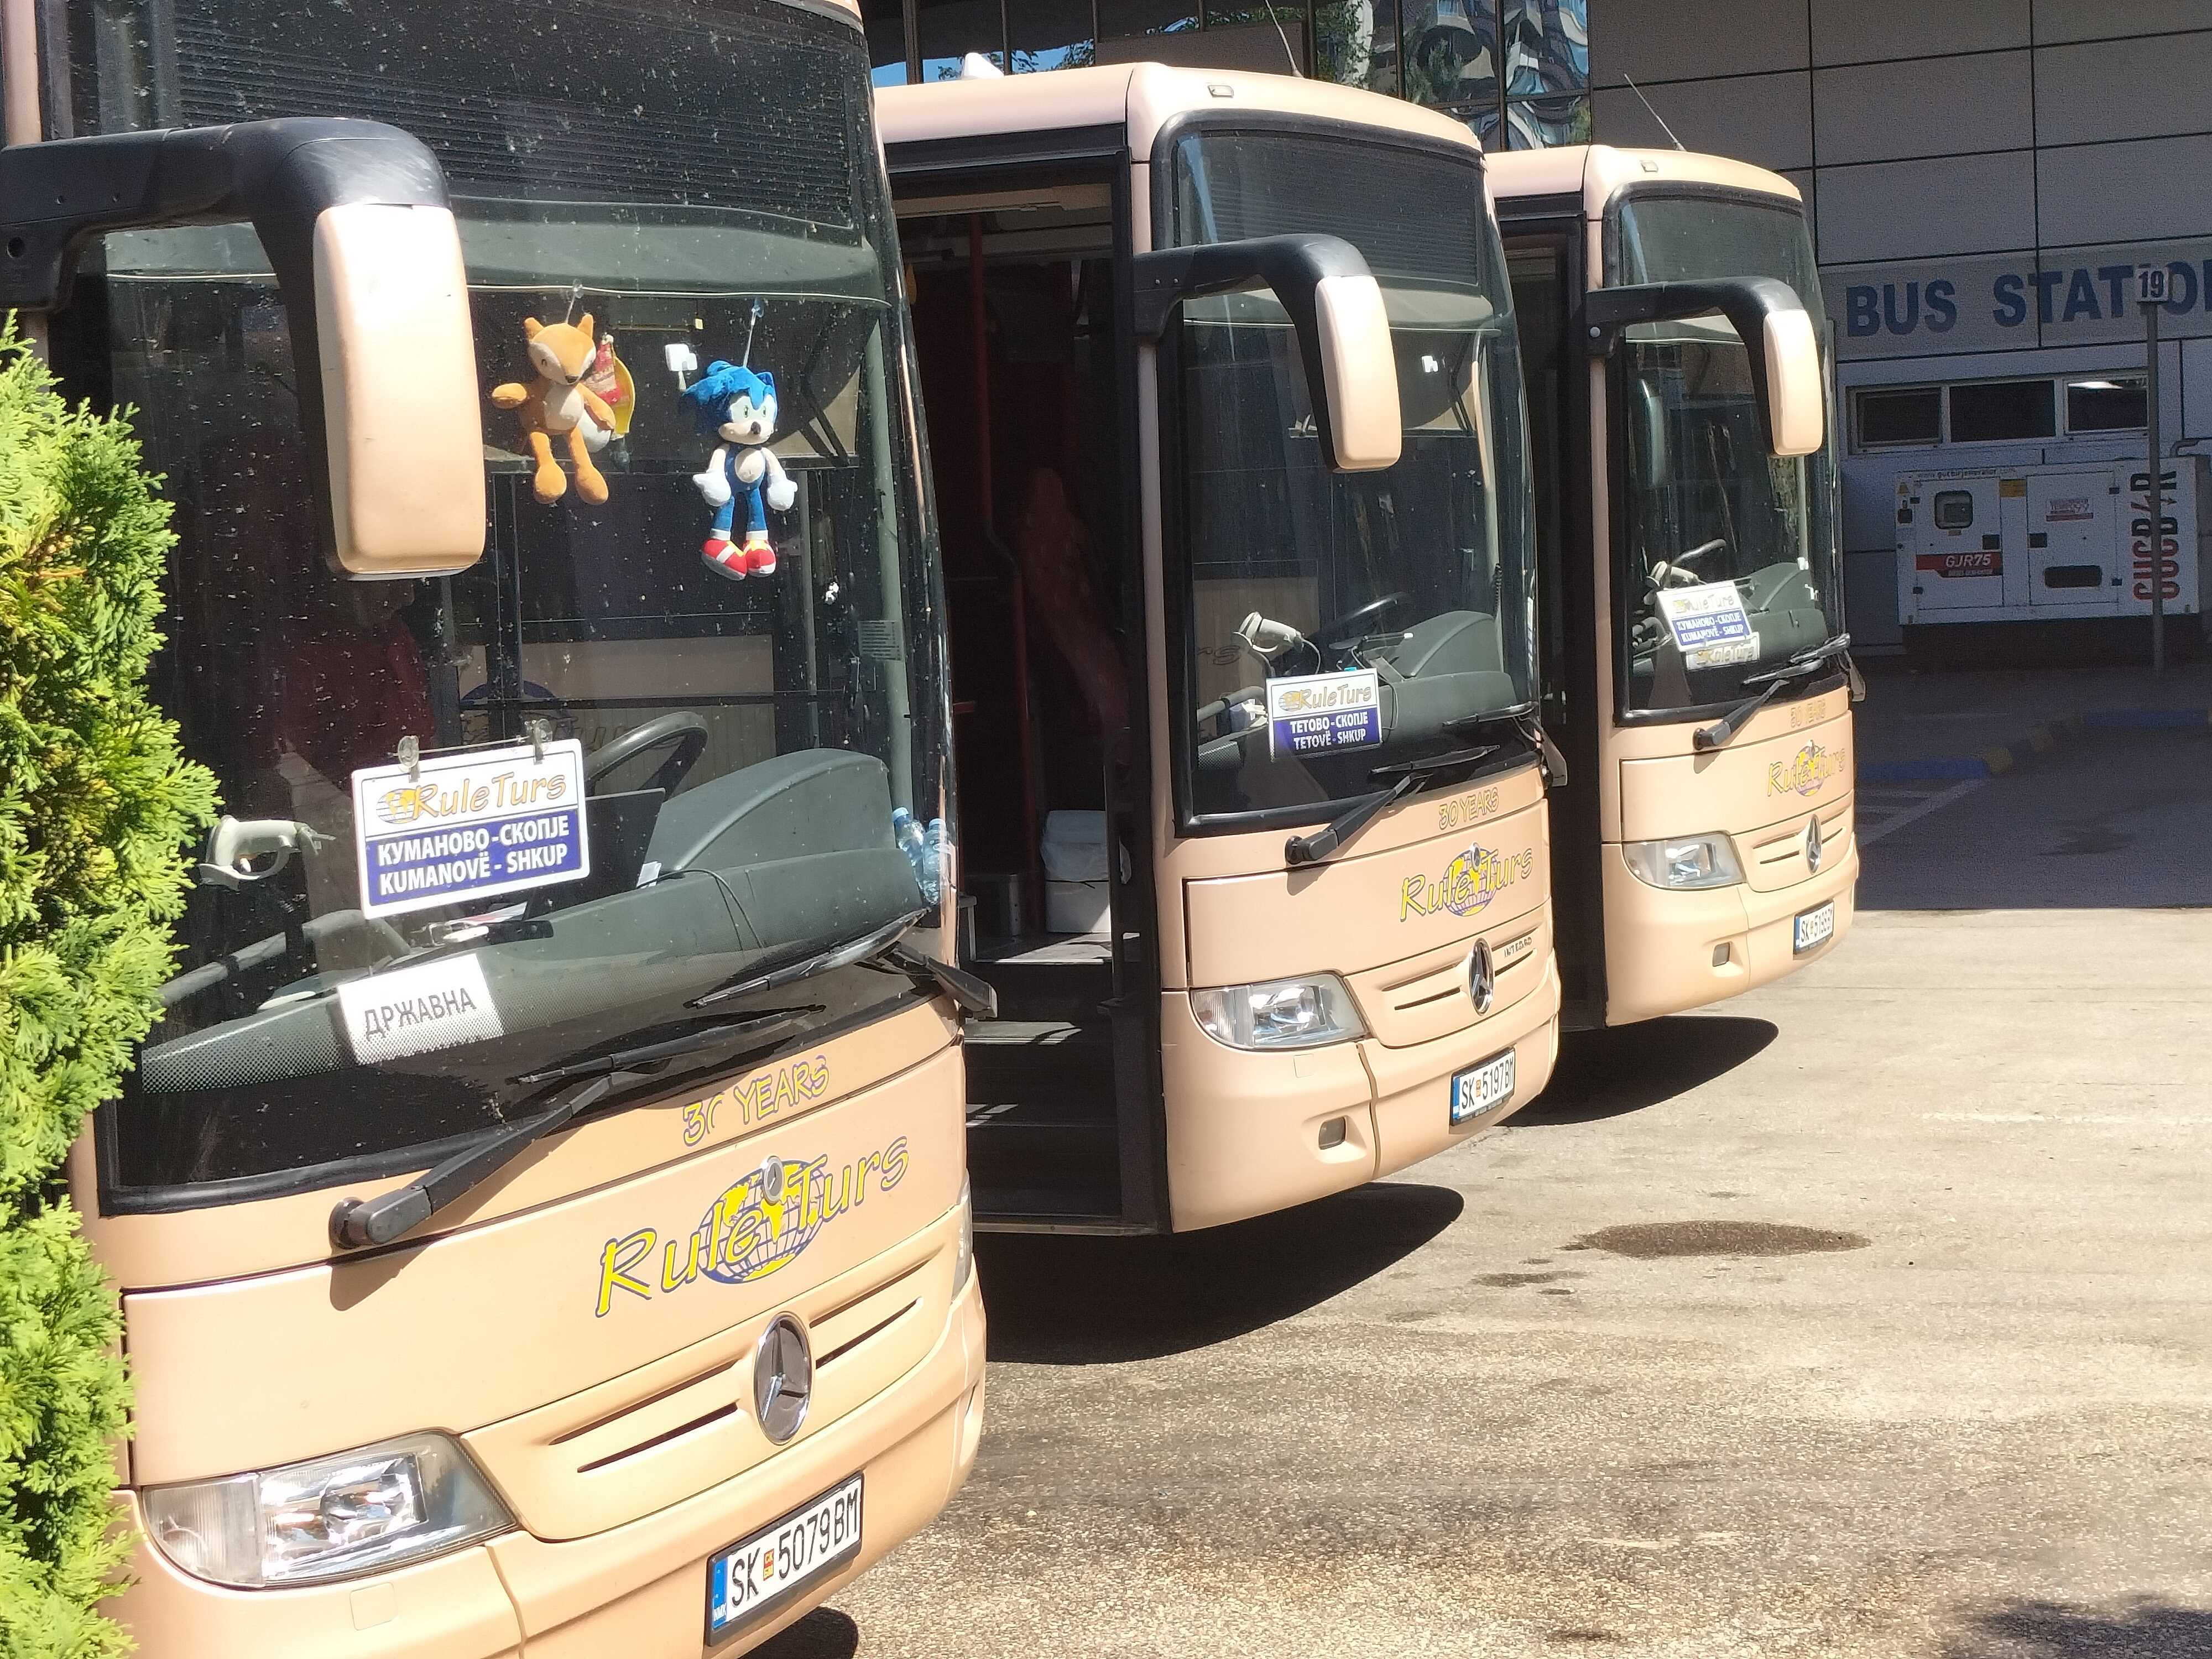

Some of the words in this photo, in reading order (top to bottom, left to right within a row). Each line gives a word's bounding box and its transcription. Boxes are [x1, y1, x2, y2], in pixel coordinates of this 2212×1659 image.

[1846, 279, 1957, 337] BUS
[1992, 260, 2212, 327] STATO
[2138, 270, 2164, 298] 19
[1945, 554, 1991, 567] GJR75
[1439, 801, 1458, 830] 30
[1460, 787, 1500, 822] YEARS
[380, 852, 491, 896] KUMANOVË
[507, 844, 567, 874] SHKUP
[363, 987, 477, 1042] ДРЖАВНА
[734, 1055, 830, 1125] YEARS
[732, 1547, 760, 1607] SK
